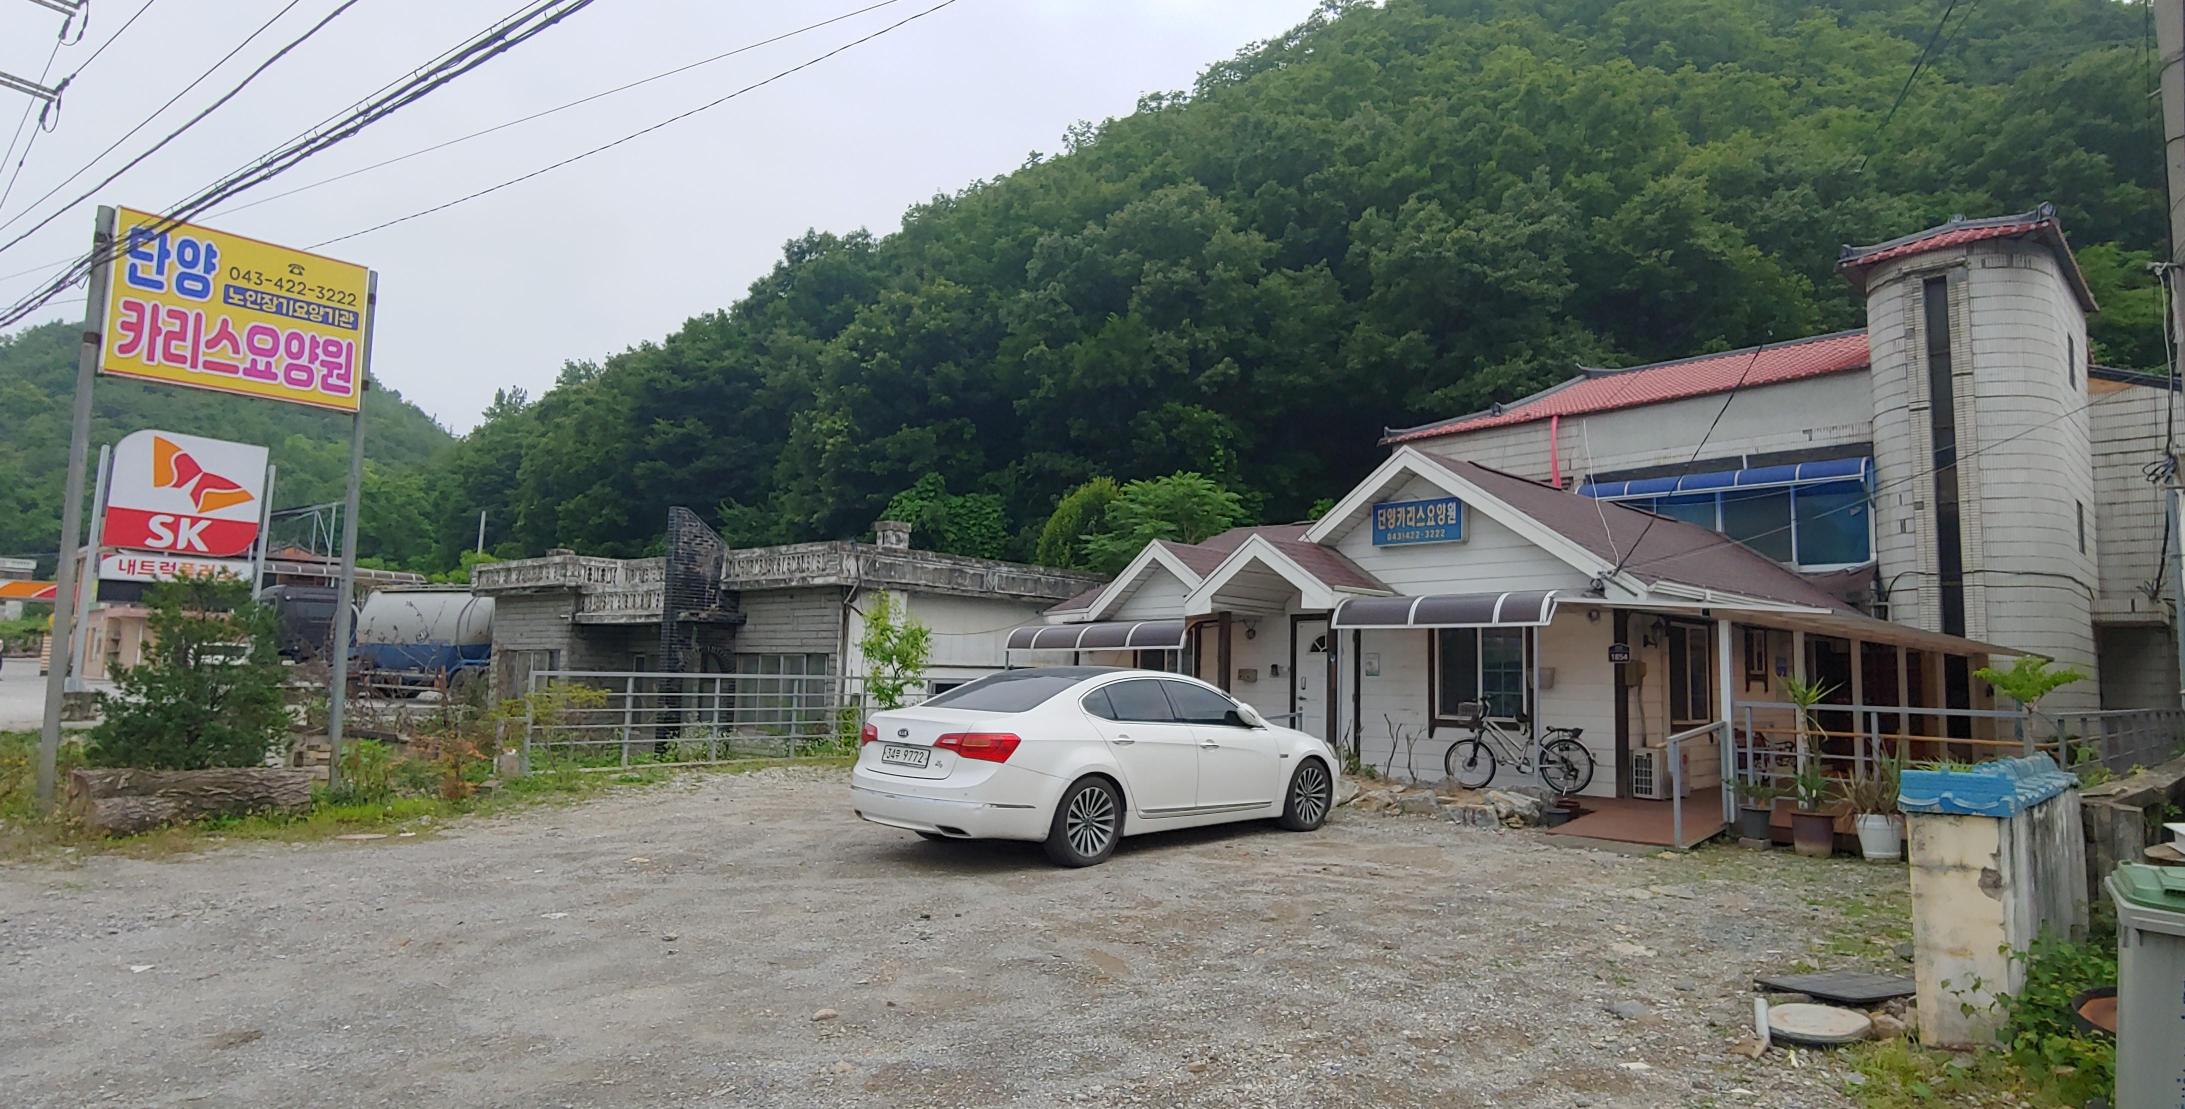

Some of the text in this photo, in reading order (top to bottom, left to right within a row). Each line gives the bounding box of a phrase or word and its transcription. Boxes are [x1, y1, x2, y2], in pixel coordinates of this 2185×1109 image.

[128, 227, 218, 299] 단양
[229, 266, 357, 307] 043-422-3222
[228, 287, 355, 328] 노인장기요양기관
[117, 299, 354, 395] 카리스요양원
[144, 514, 213, 552] SK
[1377, 502, 1457, 530] 단양카리스요양원
[903, 750, 925, 763] 9772
